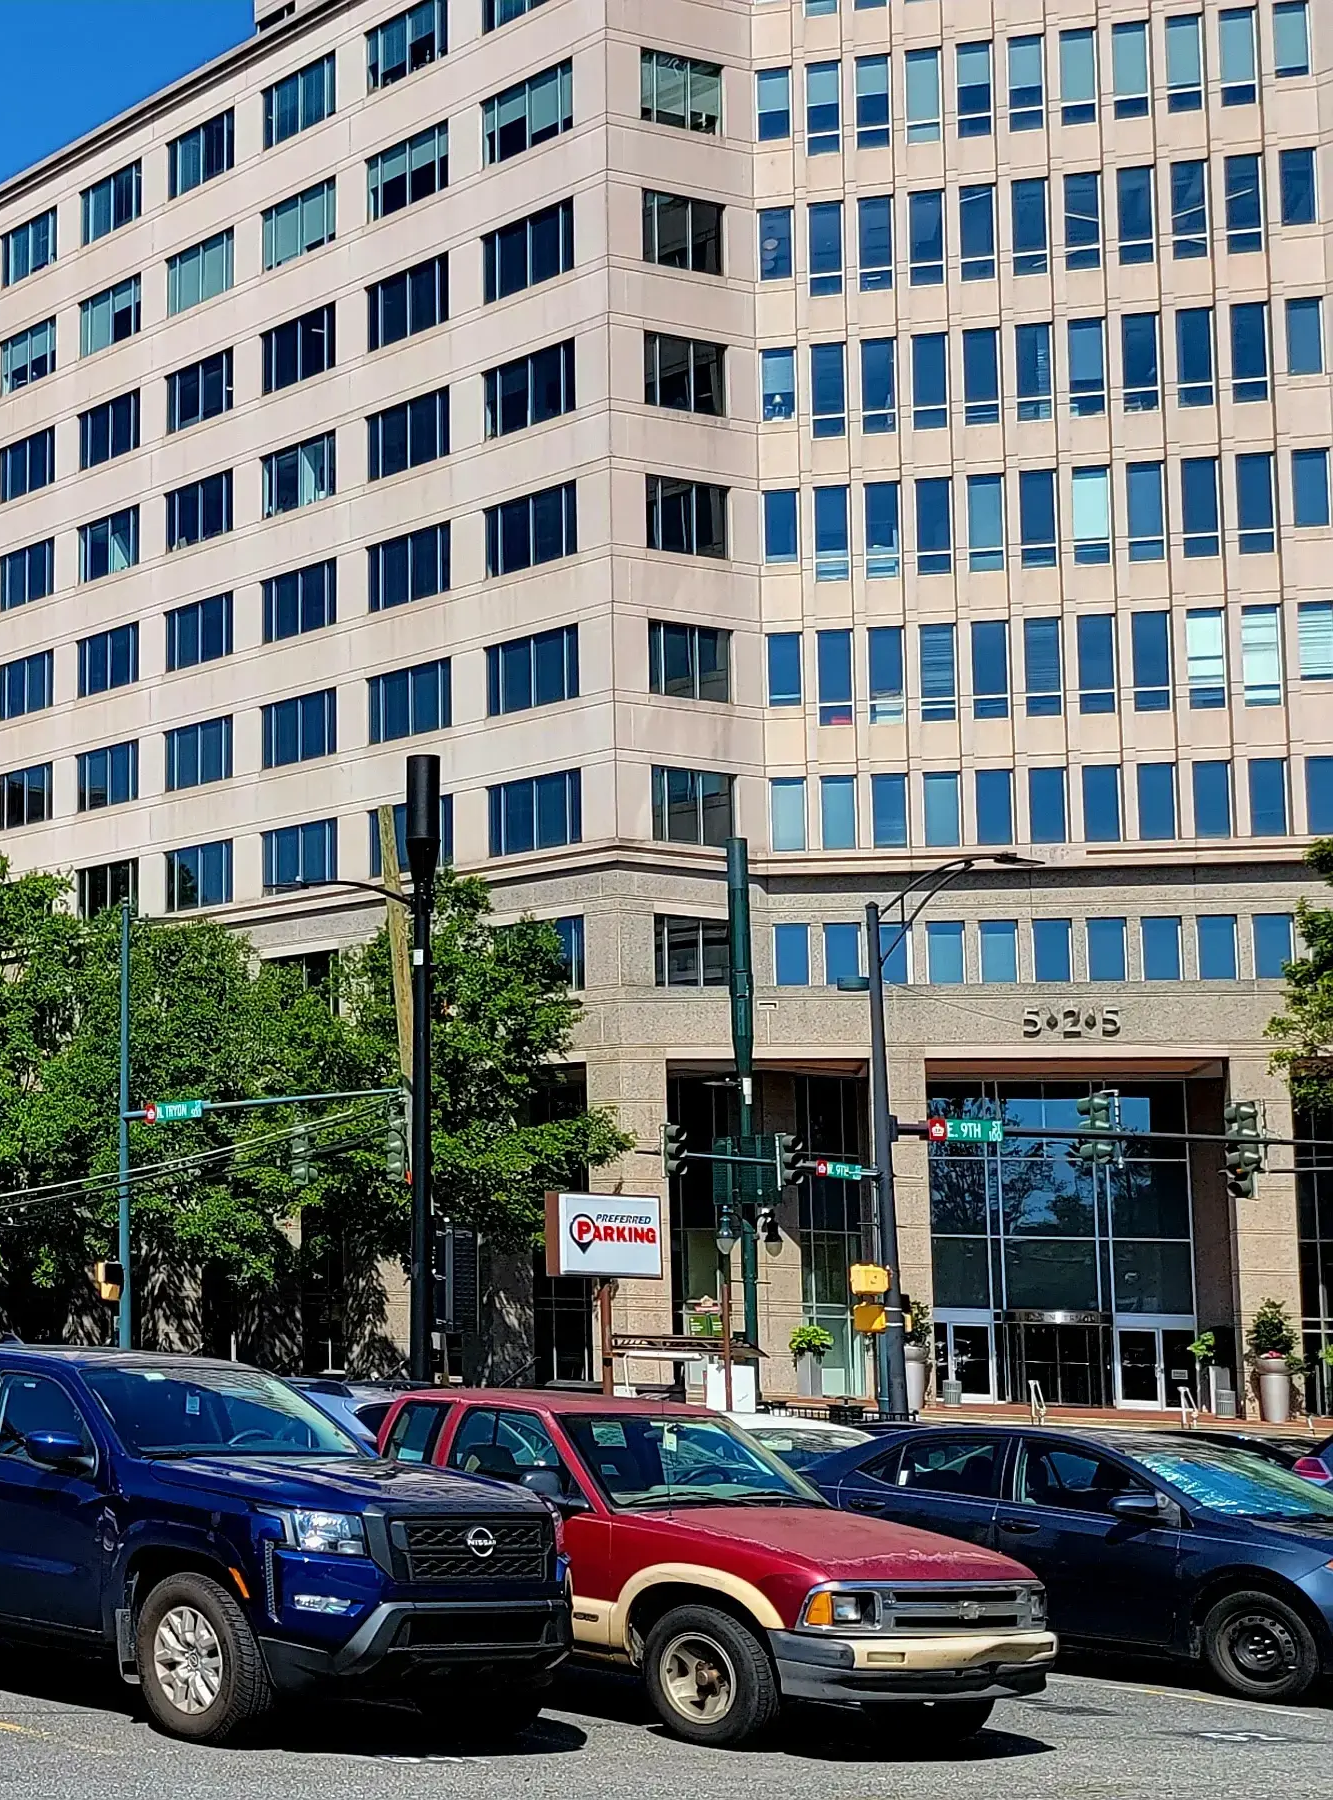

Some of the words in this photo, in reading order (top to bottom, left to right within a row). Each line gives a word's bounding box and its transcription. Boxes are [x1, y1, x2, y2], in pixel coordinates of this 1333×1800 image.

[165, 1104, 187, 1118] TRYON
[947, 1122, 958, 1138] E.
[960, 1122, 982, 1138] 9TH
[992, 1121, 1002, 1131] ST
[989, 1130, 1002, 1141] 100
[595, 1213, 652, 1225] PREFERRED
[577, 1220, 657, 1244] PARKING
